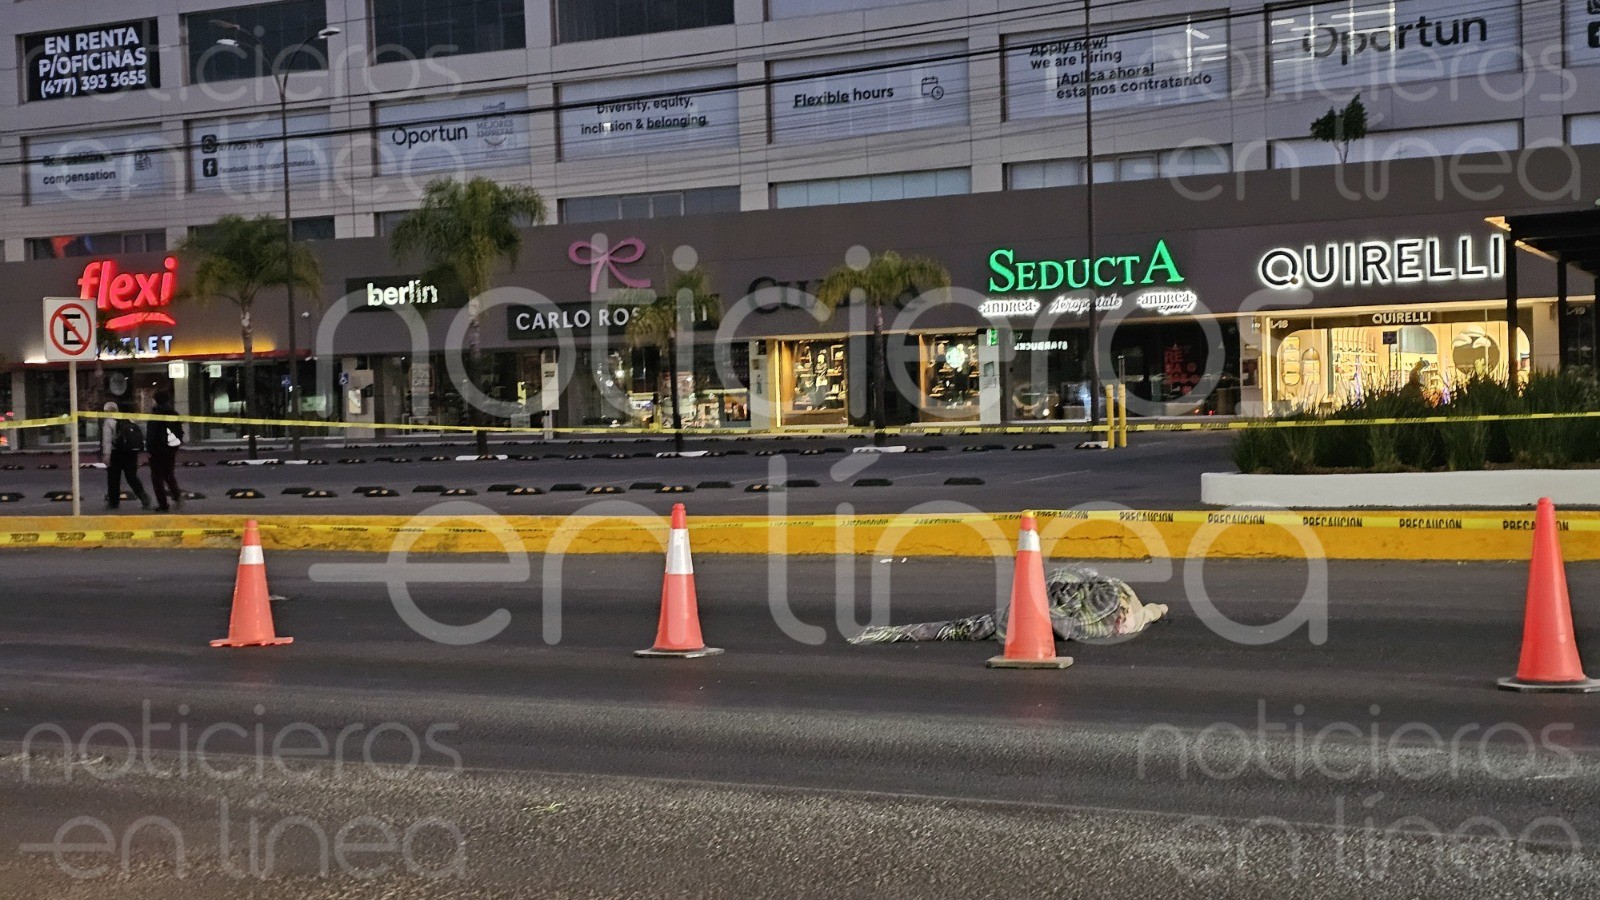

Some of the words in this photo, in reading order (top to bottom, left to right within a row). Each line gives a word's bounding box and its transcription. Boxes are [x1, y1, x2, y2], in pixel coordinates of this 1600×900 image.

[44, 35, 70, 55] EN
[75, 27, 139, 51] RENTA
[1029, 40, 1070, 56] Apply
[1302, 16, 1487, 65] Oportun
[38, 47, 147, 77] P/OFICINAS
[1030, 57, 1050, 70] we
[1055, 55, 1077, 68] are
[40, 76, 77, 98] (477)
[80, 74, 108, 91] 393
[110, 69, 147, 88] 3655
[1120, 73, 1212, 94] contratando
[653, 95, 694, 111] equity,
[793, 90, 849, 108] Flexible
[853, 87, 894, 101] hours
[635, 118, 644, 130] &
[646, 114, 707, 130] belonging
[391, 125, 468, 149] Oportun
[43, 169, 116, 185] compensation
[988, 238, 1186, 293] SEDUCTA
[1259, 232, 1505, 290] QUIRELLI
[77, 256, 179, 311] flexi
[366, 279, 438, 307] berlin
[515, 309, 591, 331] CARLO
[1371, 311, 1432, 325] QUIRELLI
